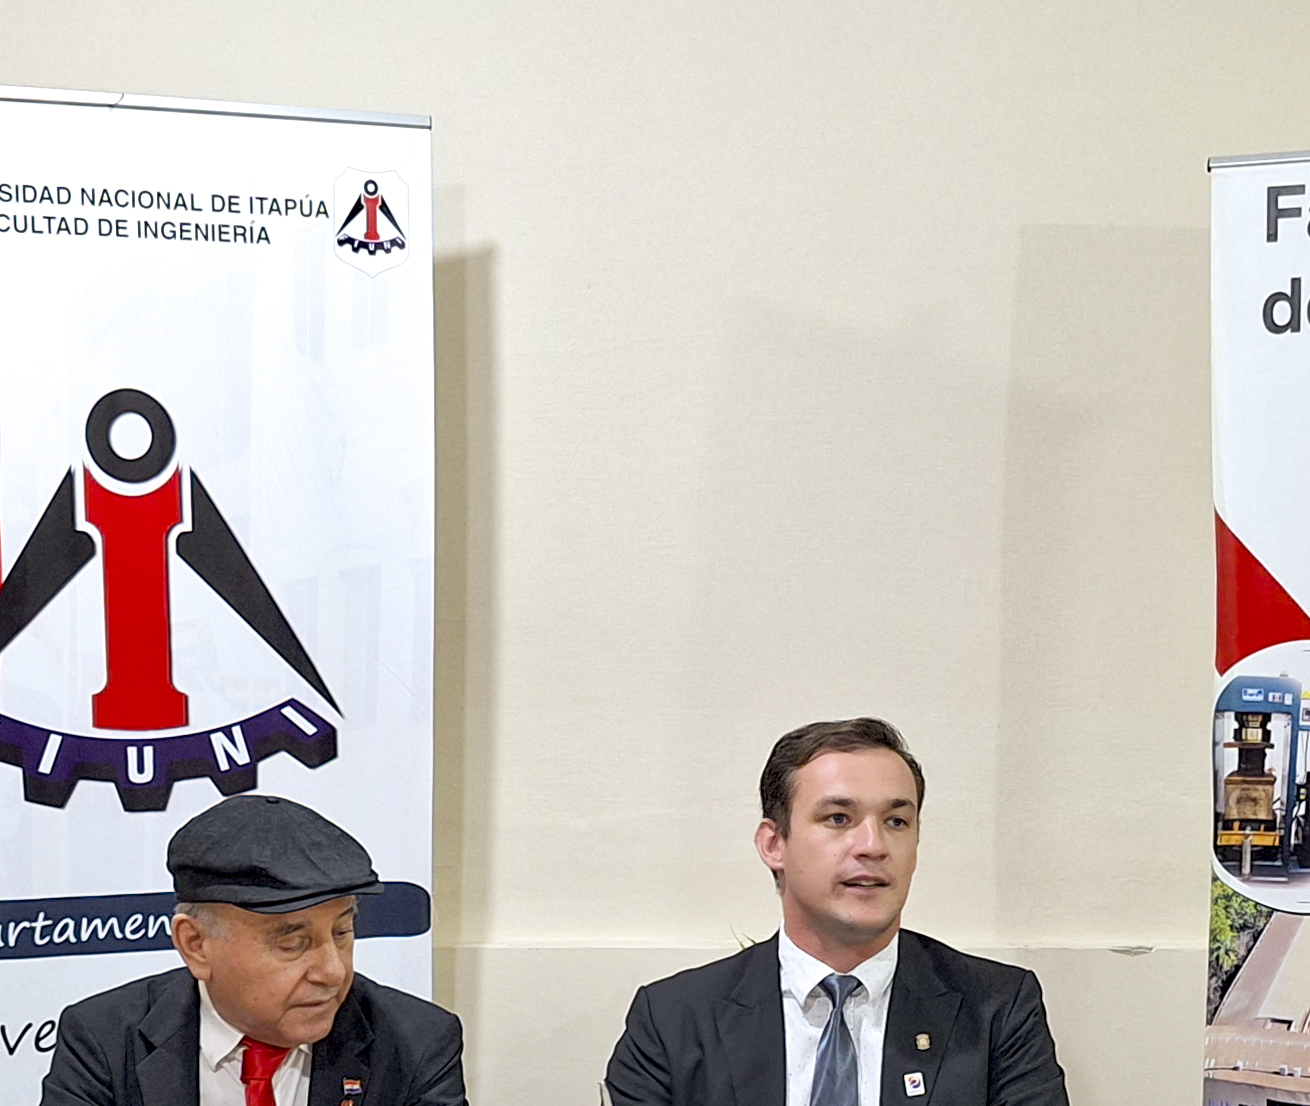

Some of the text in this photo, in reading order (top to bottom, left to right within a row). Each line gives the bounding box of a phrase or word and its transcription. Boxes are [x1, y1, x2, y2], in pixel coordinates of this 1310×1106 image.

[80, 187, 203, 212] NACIONAL
[210, 193, 241, 214] DE
[249, 193, 330, 219] ITAPÚA
[97, 217, 129, 238] DE
[137, 219, 271, 245] INGENIERÍA
